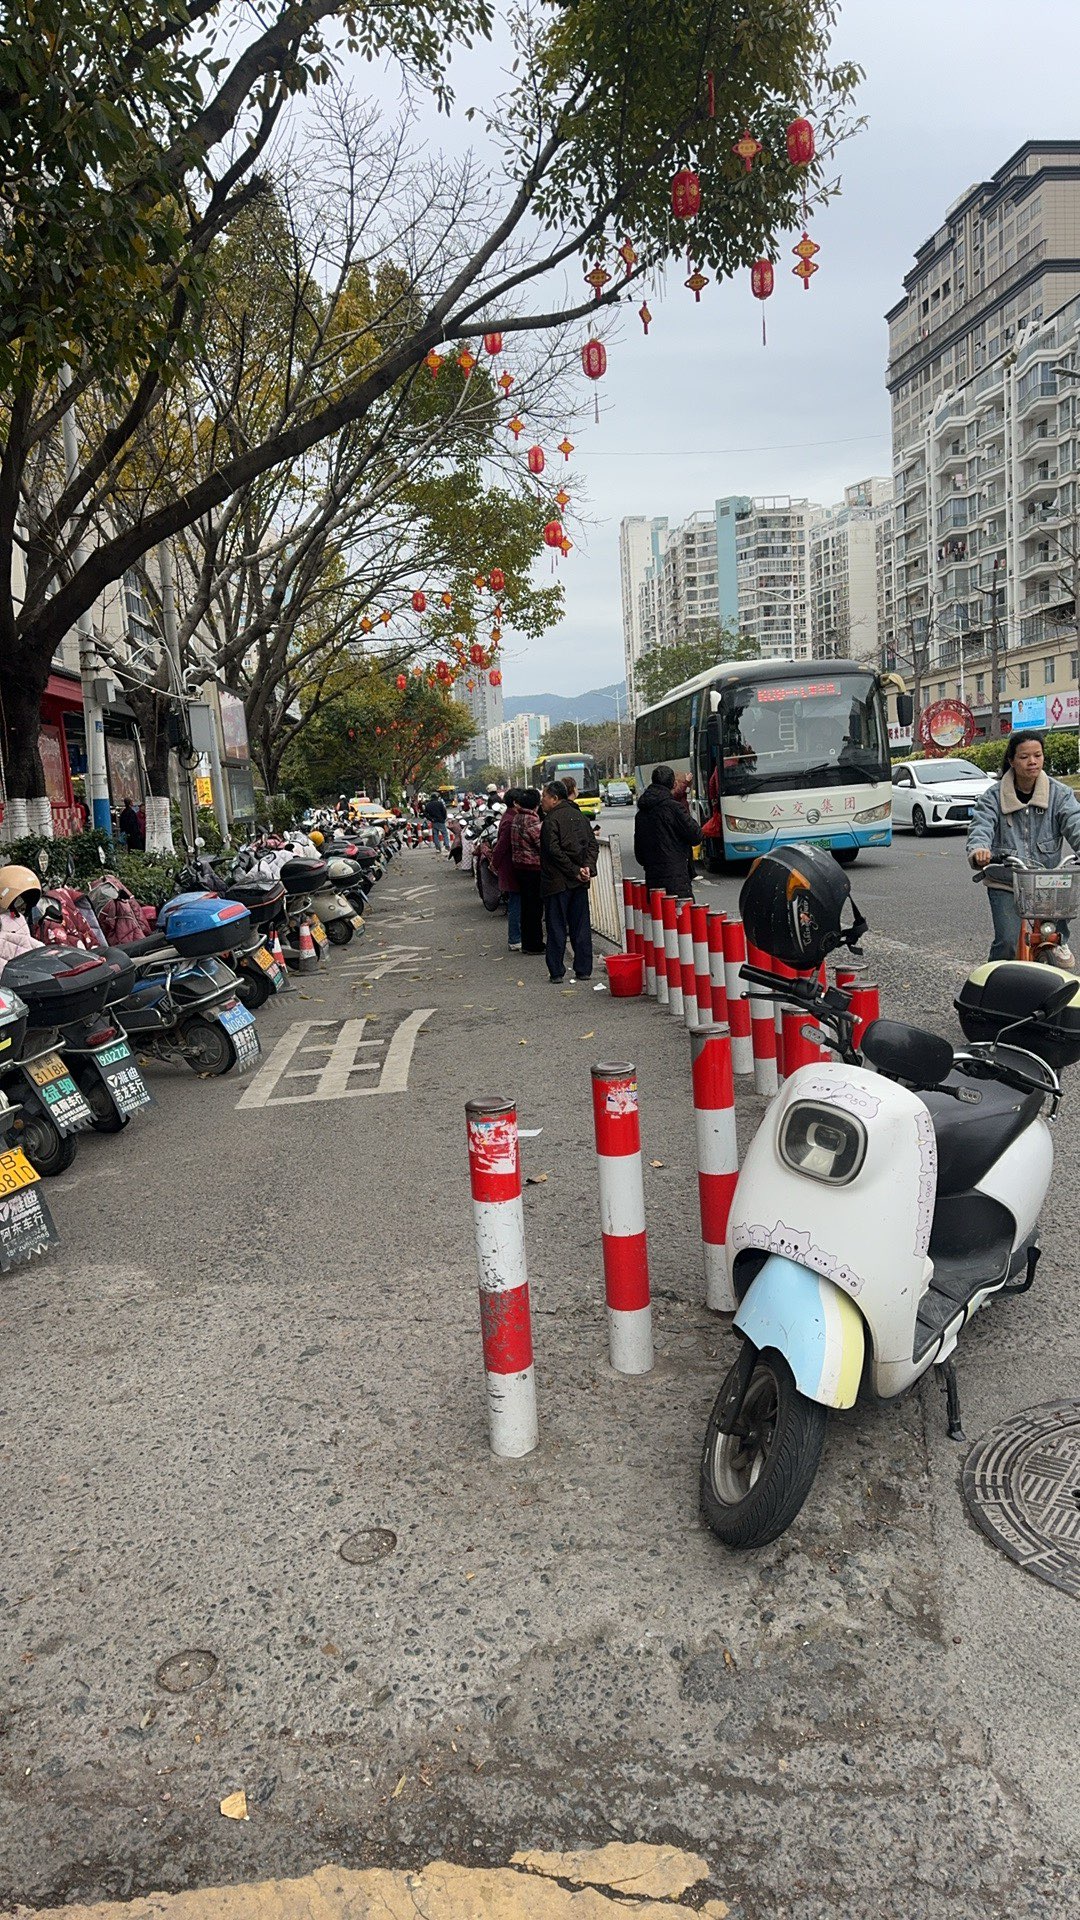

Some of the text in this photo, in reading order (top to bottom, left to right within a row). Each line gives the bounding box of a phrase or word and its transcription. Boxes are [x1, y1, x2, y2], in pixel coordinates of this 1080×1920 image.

[770, 797, 856, 817] 公交集团
[99, 1046, 128, 1065] 90272
[34, 1062, 67, 1083] 3118H
[116, 1066, 140, 1085] 雅迪
